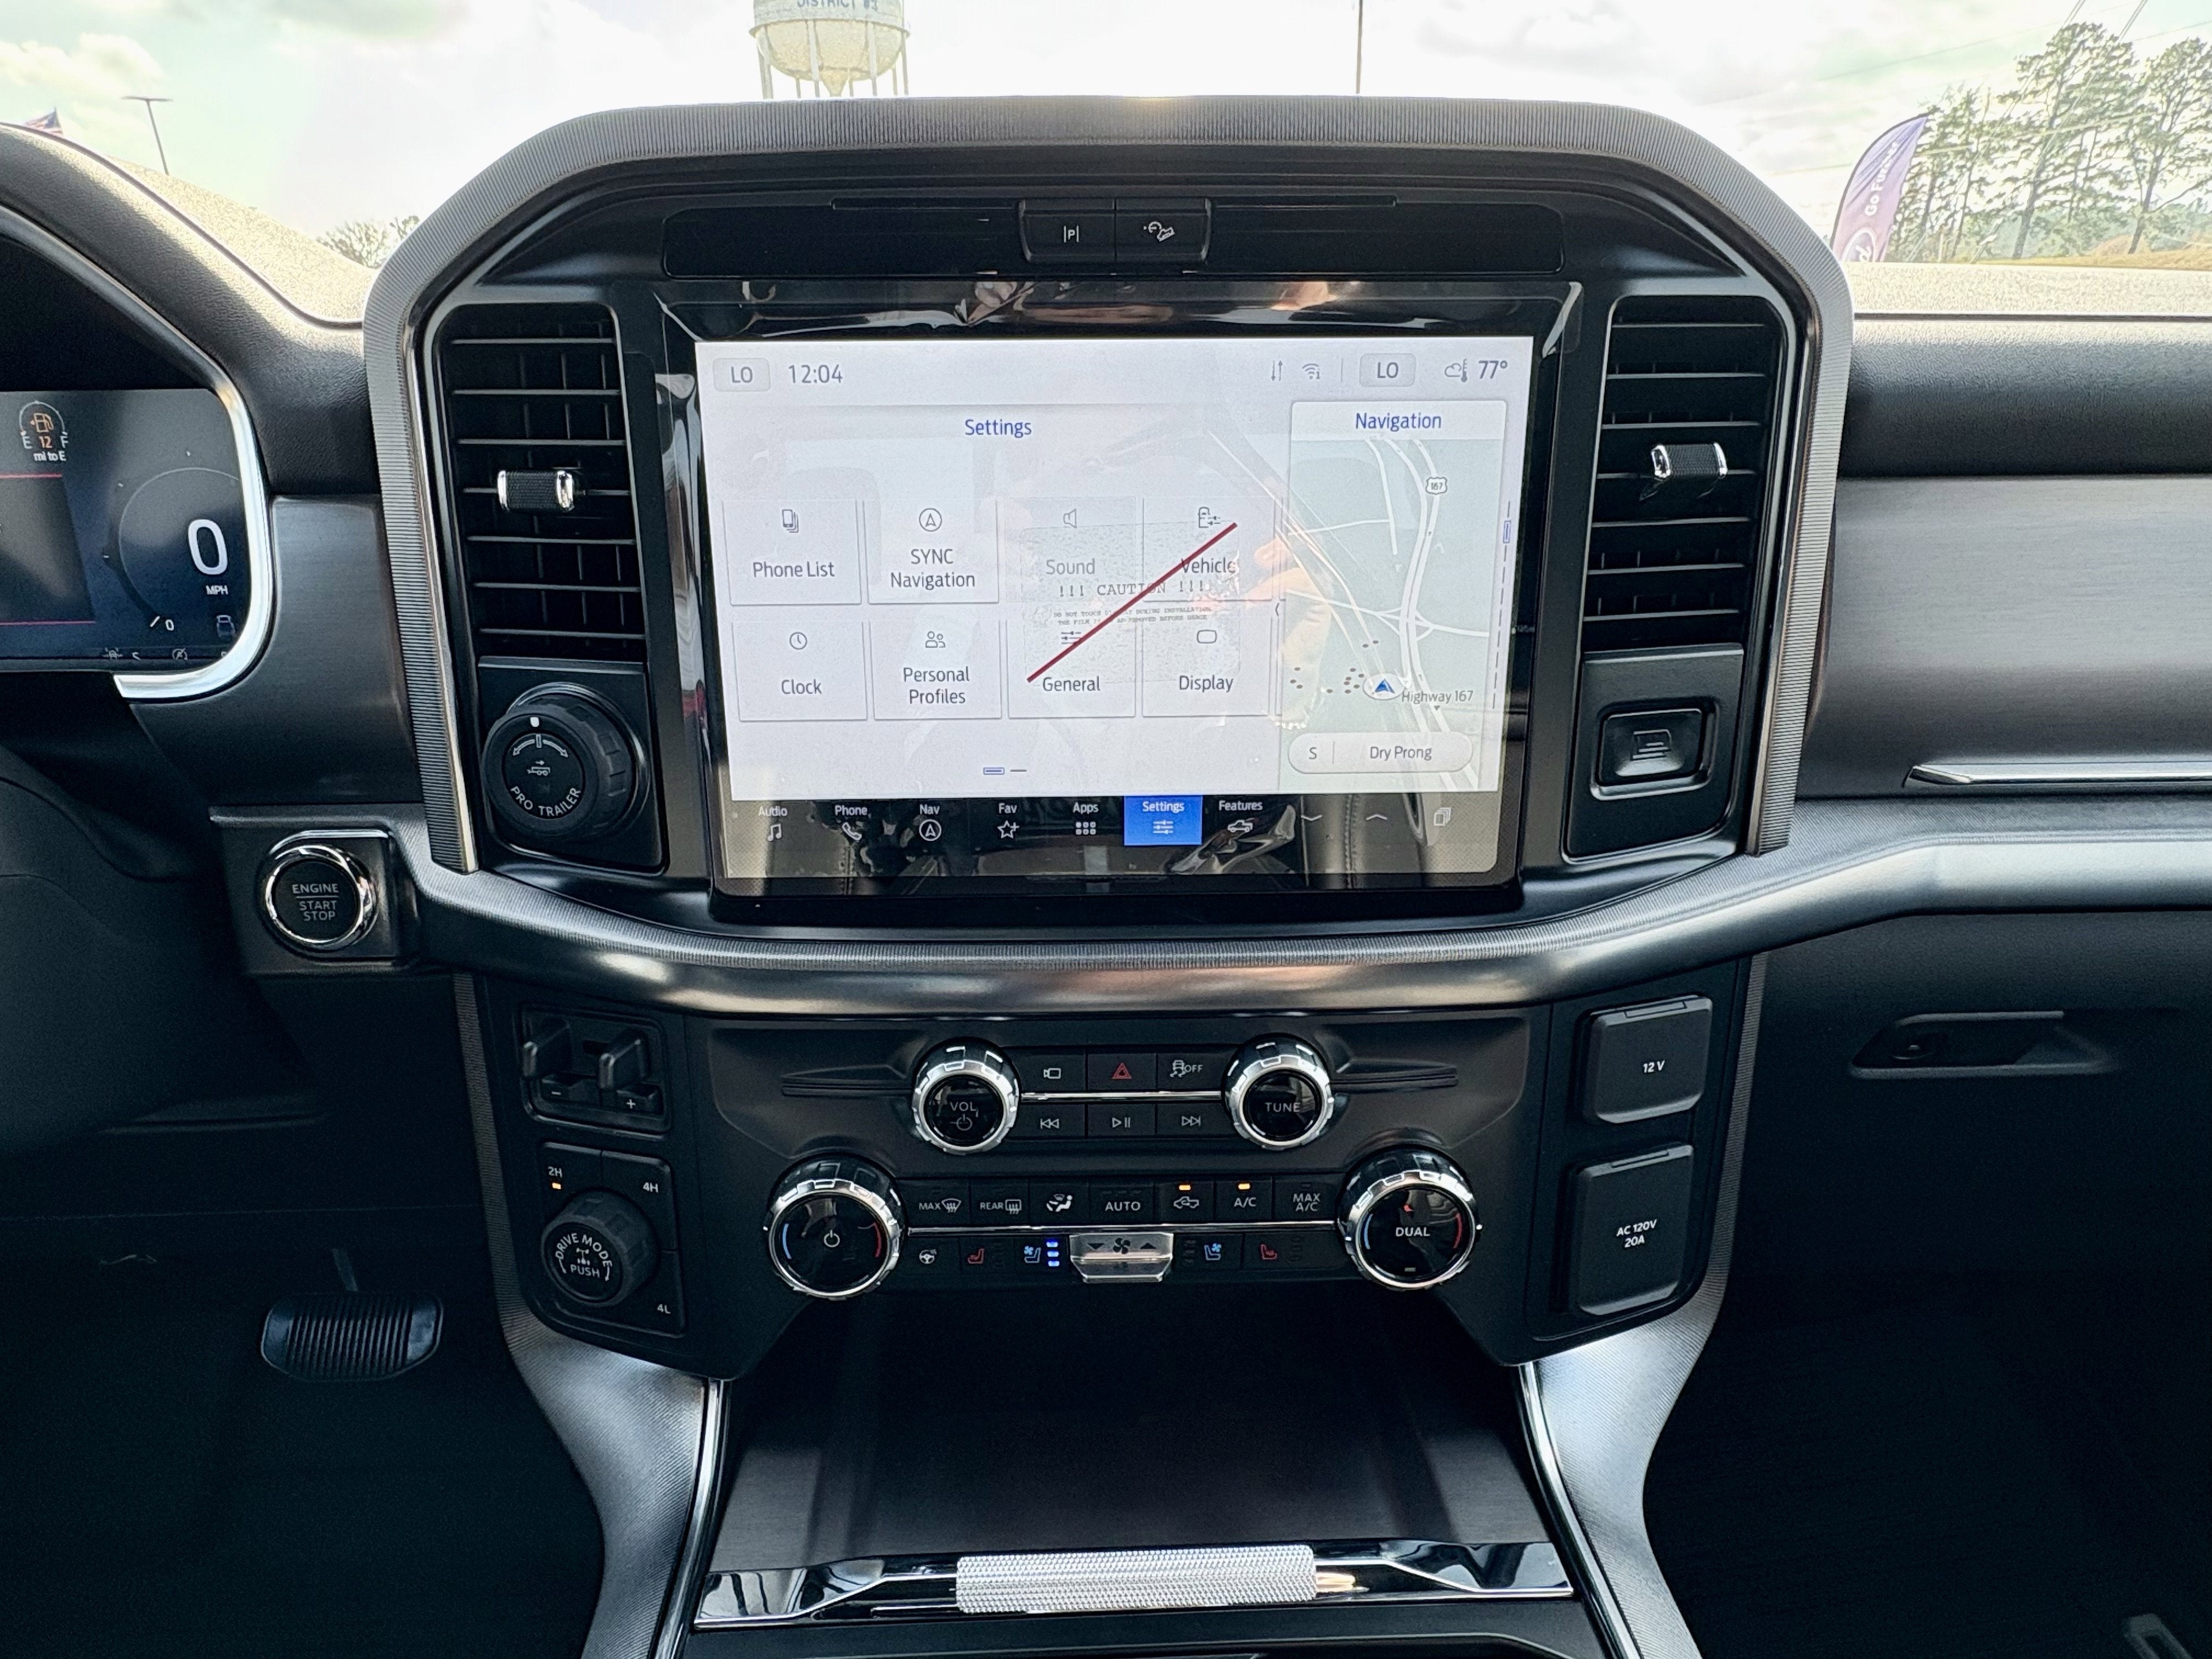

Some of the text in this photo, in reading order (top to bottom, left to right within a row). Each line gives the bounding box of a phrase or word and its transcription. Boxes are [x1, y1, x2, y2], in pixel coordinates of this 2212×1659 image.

[731, 364, 844, 384] LO 12:04
[1376, 362, 1399, 379] LO
[1478, 360, 1508, 379] 77°
[964, 419, 1032, 439] Settings
[1355, 413, 1442, 432] Navigation
[38, 436, 53, 449] 12
[58, 450, 66, 461] E
[188, 519, 228, 575] 0
[910, 549, 954, 565] SYNC
[752, 561, 836, 578] Phone List
[1046, 558, 1096, 575] Sound
[1181, 556, 1237, 574] Vehicle
[890, 571, 975, 591] Navigation
[206, 585, 228, 595] MPH
[903, 667, 970, 682] Personal
[781, 678, 822, 695] Clock
[1042, 676, 1101, 692] General
[1178, 675, 1234, 693] Display
[909, 689, 966, 704] Profiles
[1401, 690, 1474, 704] Highway 167
[1308, 746, 1432, 761] S Dry Prong
[510, 786, 582, 817] PRO TRAILER
[1142, 799, 1186, 814] Settings
[1218, 799, 1263, 812] Features
[758, 805, 788, 817] Audio
[834, 804, 868, 816] Phone
[919, 804, 940, 815] Nav
[998, 803, 1018, 814] Fav
[1073, 802, 1099, 816] Apps
[292, 883, 339, 894] ENGINE
[299, 900, 337, 911] START
[303, 910, 336, 922] STOP
[1184, 1063, 1203, 1074] OFF
[1643, 1060, 1666, 1074] 12 V
[950, 1101, 977, 1113] VOL
[1265, 1102, 1300, 1113] TUNE
[548, 1166, 563, 1178] 2H
[642, 1182, 659, 1193] 4H
[1233, 1197, 1257, 1208] A/C
[1293, 1193, 1321, 1204] MAX
[918, 1202, 941, 1210] MAX
[980, 1201, 1004, 1210] REAR
[1105, 1201, 1141, 1211] AUTO
[1295, 1201, 1318, 1212] A/C
[1395, 1226, 1431, 1238] DUAL
[1616, 1219, 1657, 1238] AC 120V
[1624, 1235, 1645, 1248] 20A
[555, 1233, 613, 1267] DRIVE MODE
[569, 1263, 600, 1278] PUSH
[657, 1303, 672, 1314] 4L
